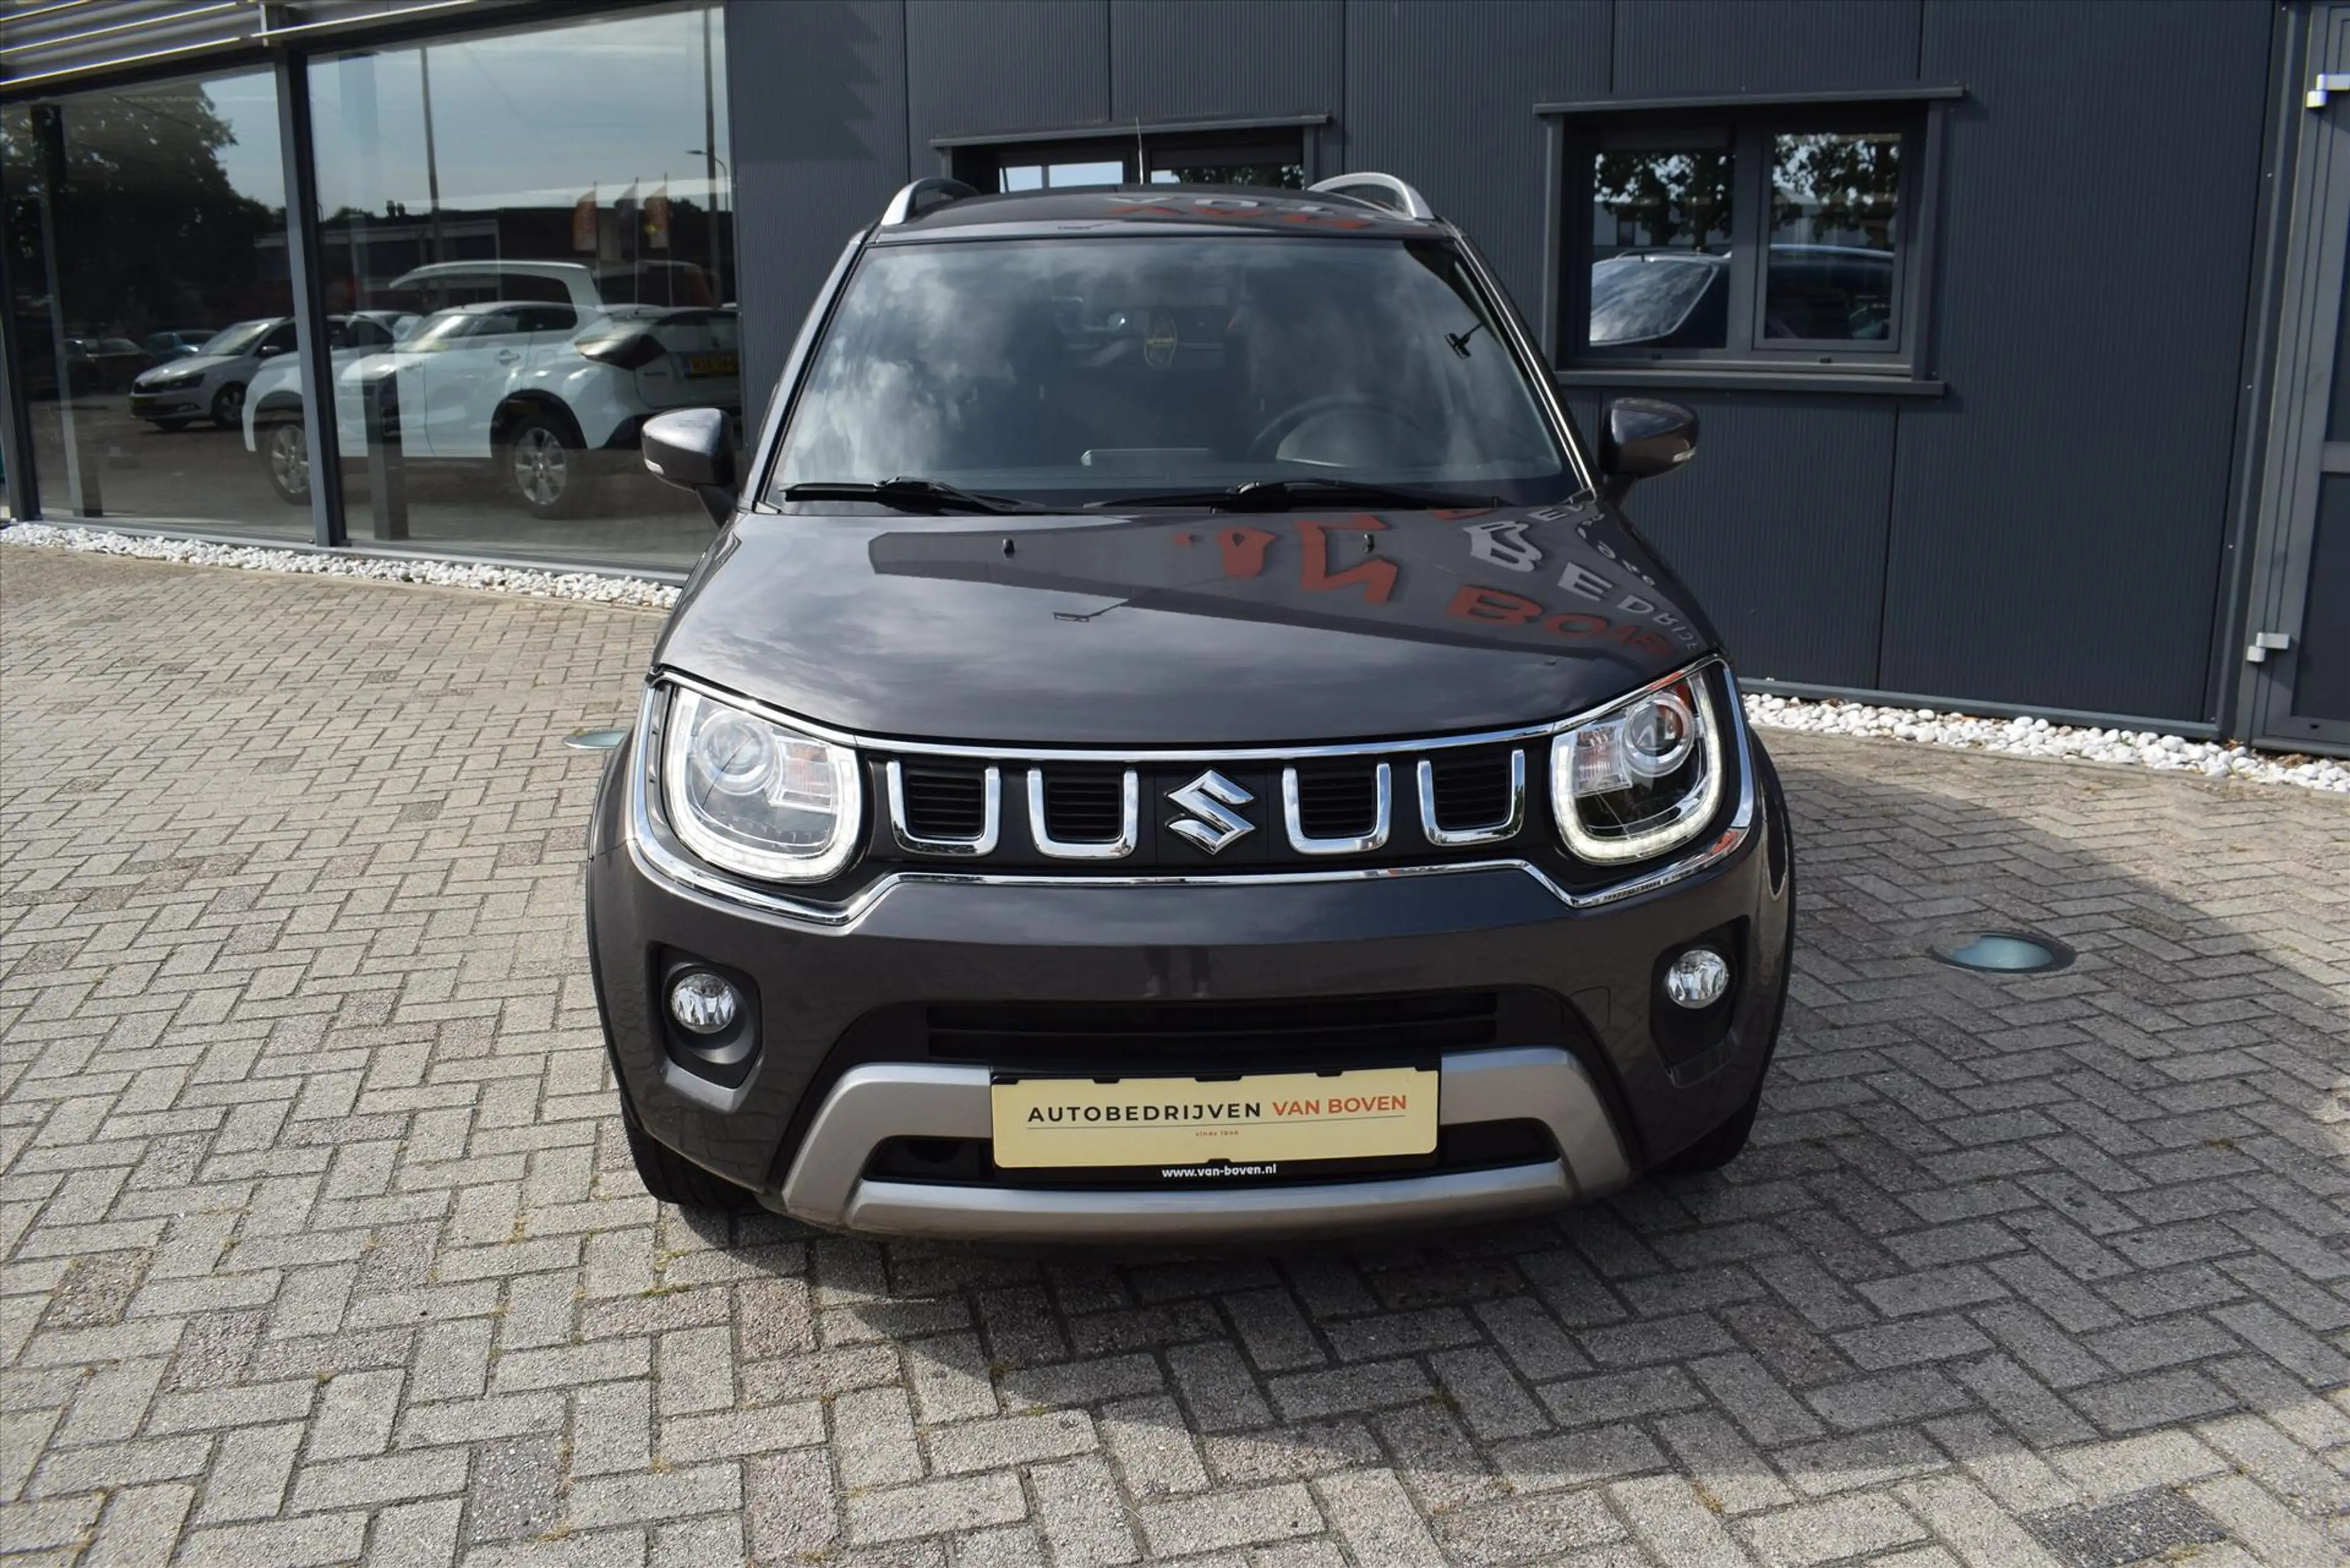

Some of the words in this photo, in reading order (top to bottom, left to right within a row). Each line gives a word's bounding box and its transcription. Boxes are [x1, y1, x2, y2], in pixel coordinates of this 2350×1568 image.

[1028, 1102, 1261, 1122] AUTOBEDRIJVEN
[1272, 1100, 1320, 1116] VAN
[1328, 1095, 1407, 1114] BOVEN
[1162, 1164, 1277, 1179] www.van-boven.nl
